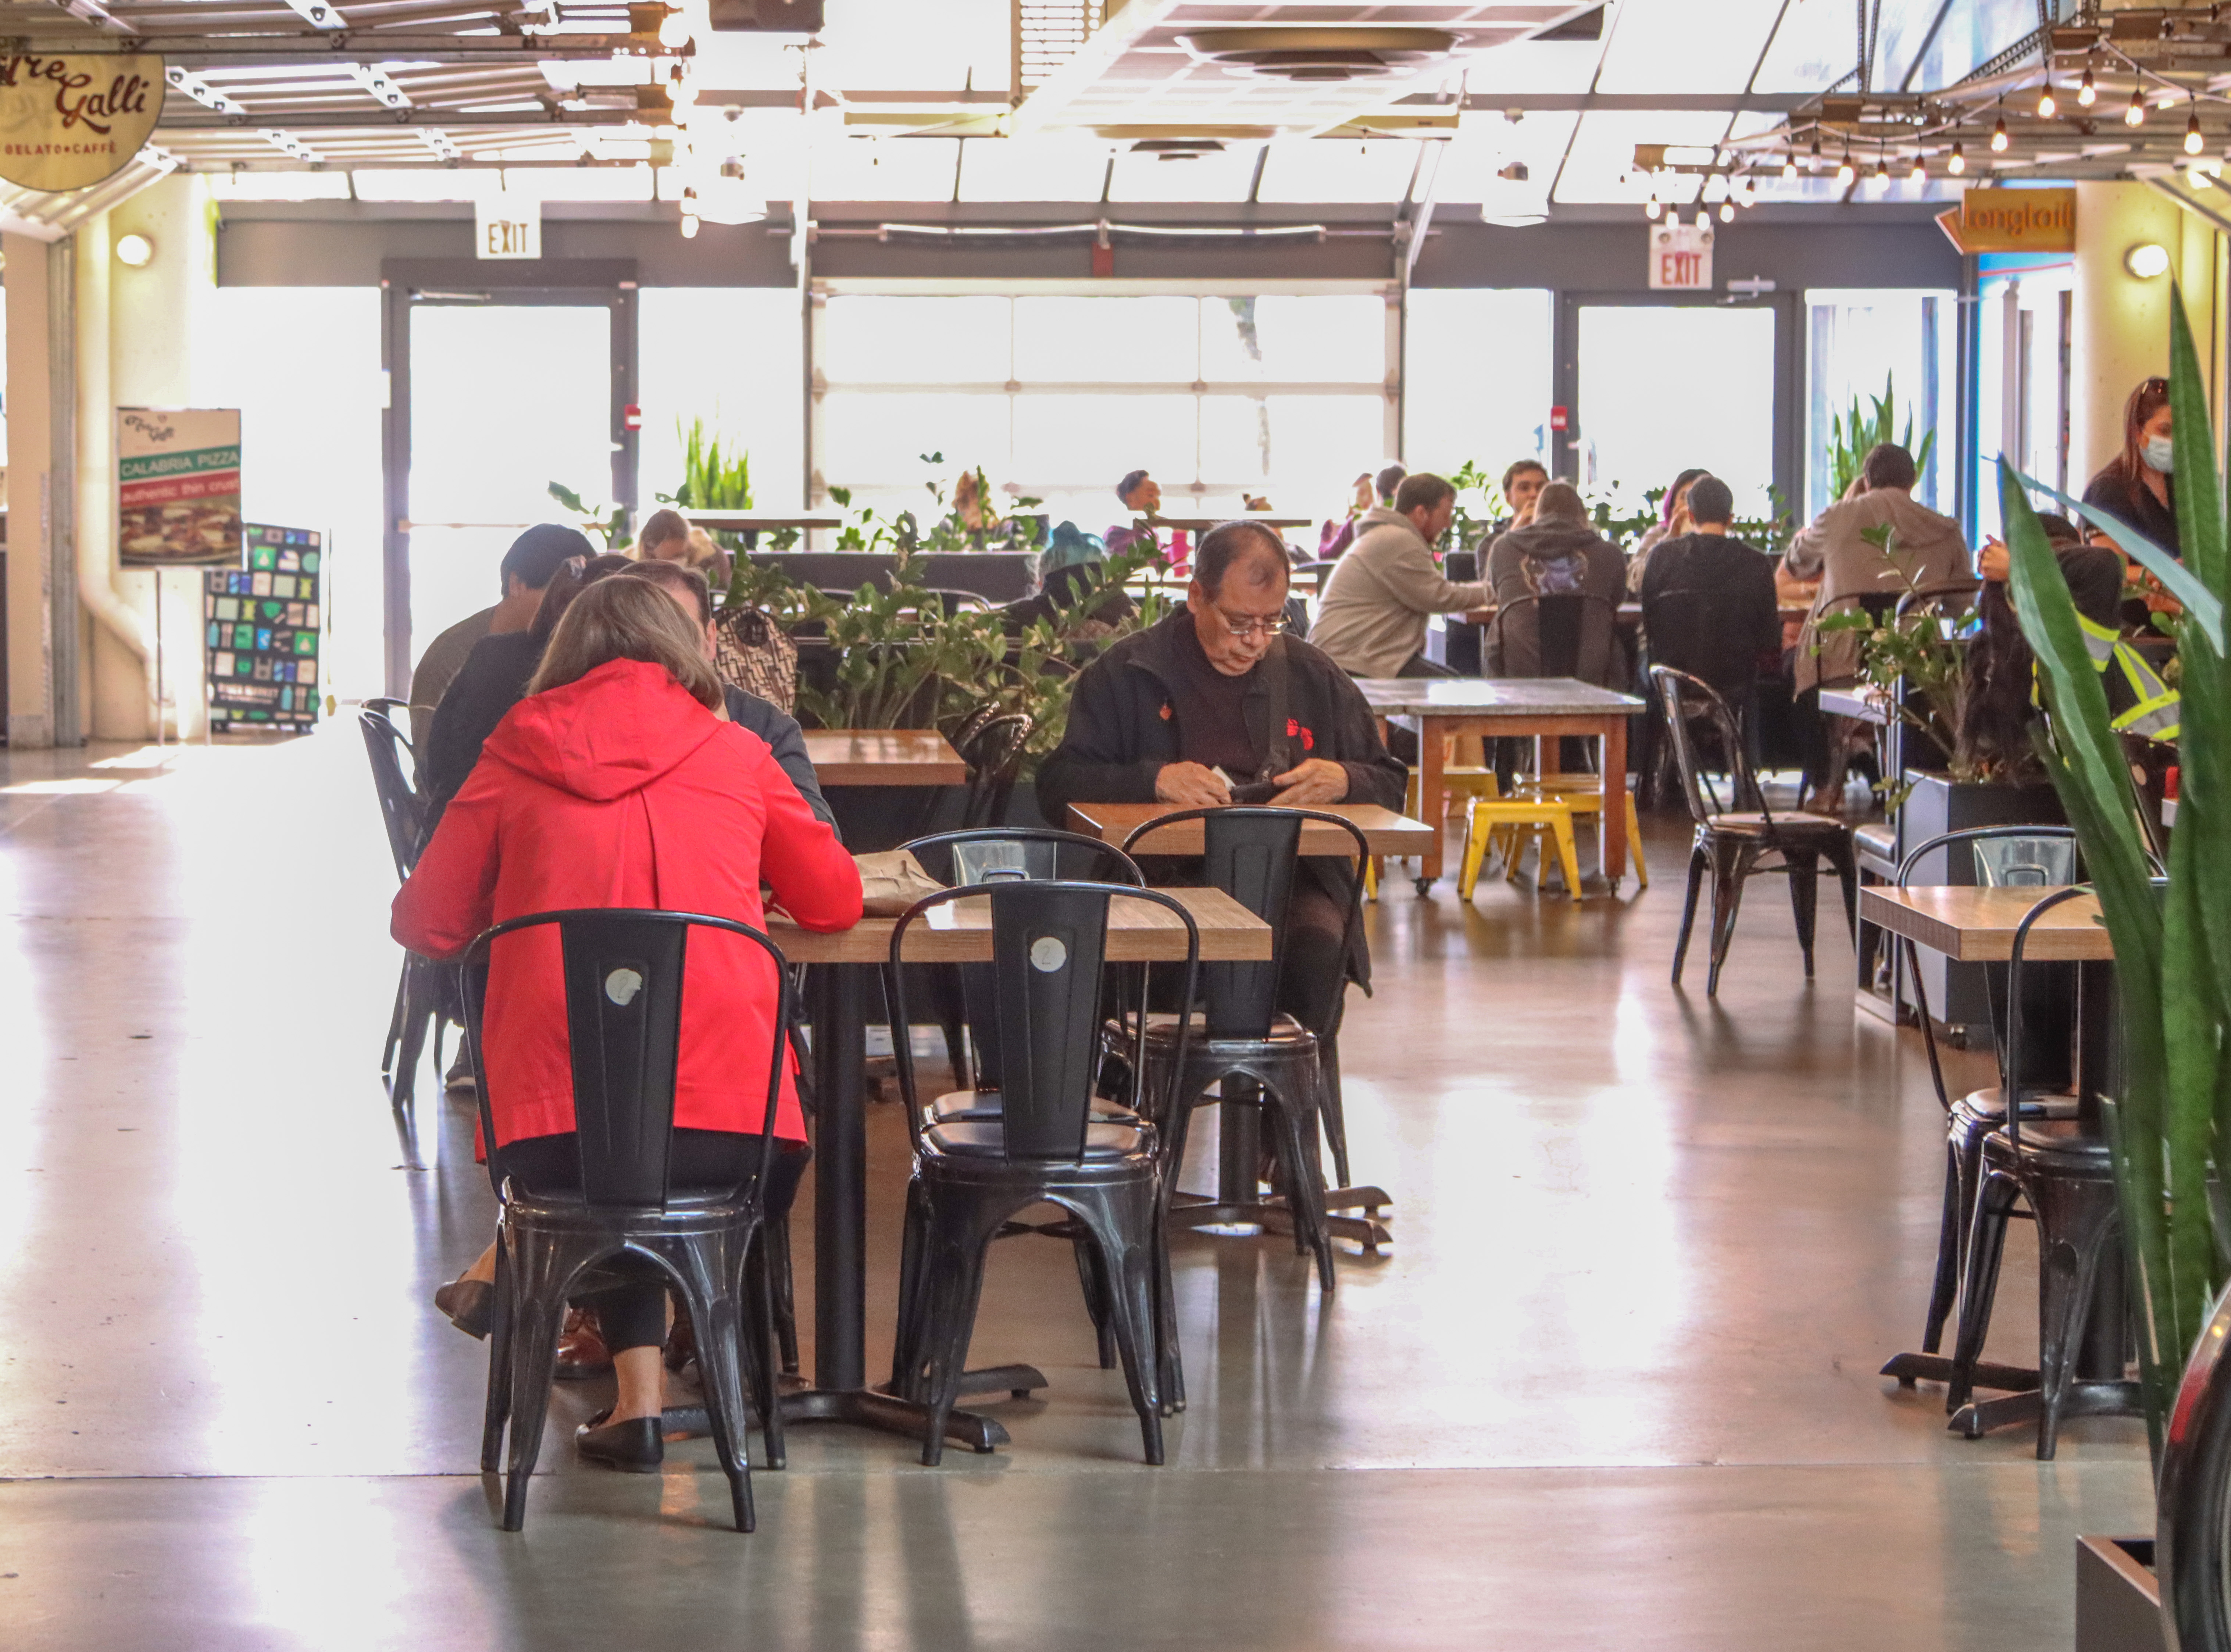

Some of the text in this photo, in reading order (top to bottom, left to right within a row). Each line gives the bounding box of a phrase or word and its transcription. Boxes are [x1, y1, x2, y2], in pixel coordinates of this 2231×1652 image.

[55, 74, 150, 135] Galli
[488, 223, 528, 254] EXIT
[1661, 253, 1702, 285] EXIT
[121, 451, 238, 477] CALABRIA PIZZA
